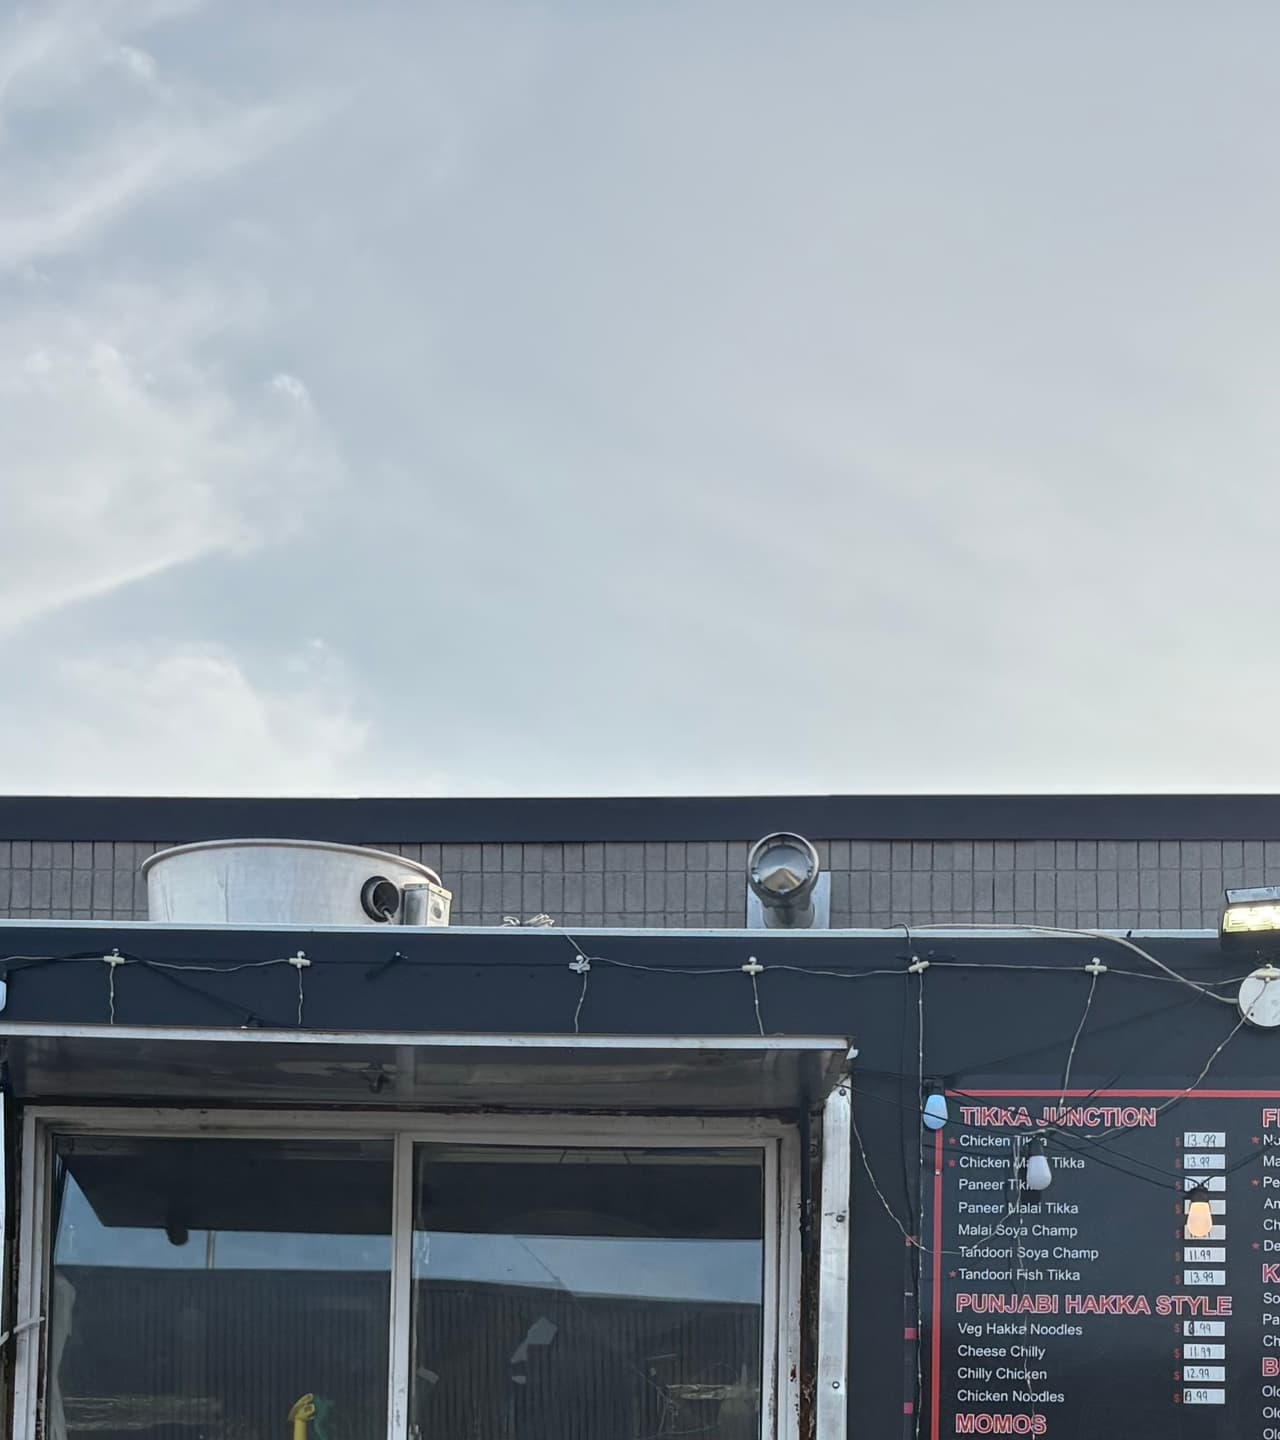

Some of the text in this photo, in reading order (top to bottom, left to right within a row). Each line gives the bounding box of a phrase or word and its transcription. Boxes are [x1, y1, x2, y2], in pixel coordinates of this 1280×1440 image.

[959, 1106, 1157, 1127] TIKKA JUNCTION
[959, 1133, 1010, 1148] Chicken
[958, 1246, 1098, 1263] Tandoori Soya Champ
[955, 1294, 1232, 1315] PUNJABI HAKKA STYLE
[957, 1345, 1045, 1361] Cheese Chilly
[955, 1413, 1047, 1434] MOMOS
